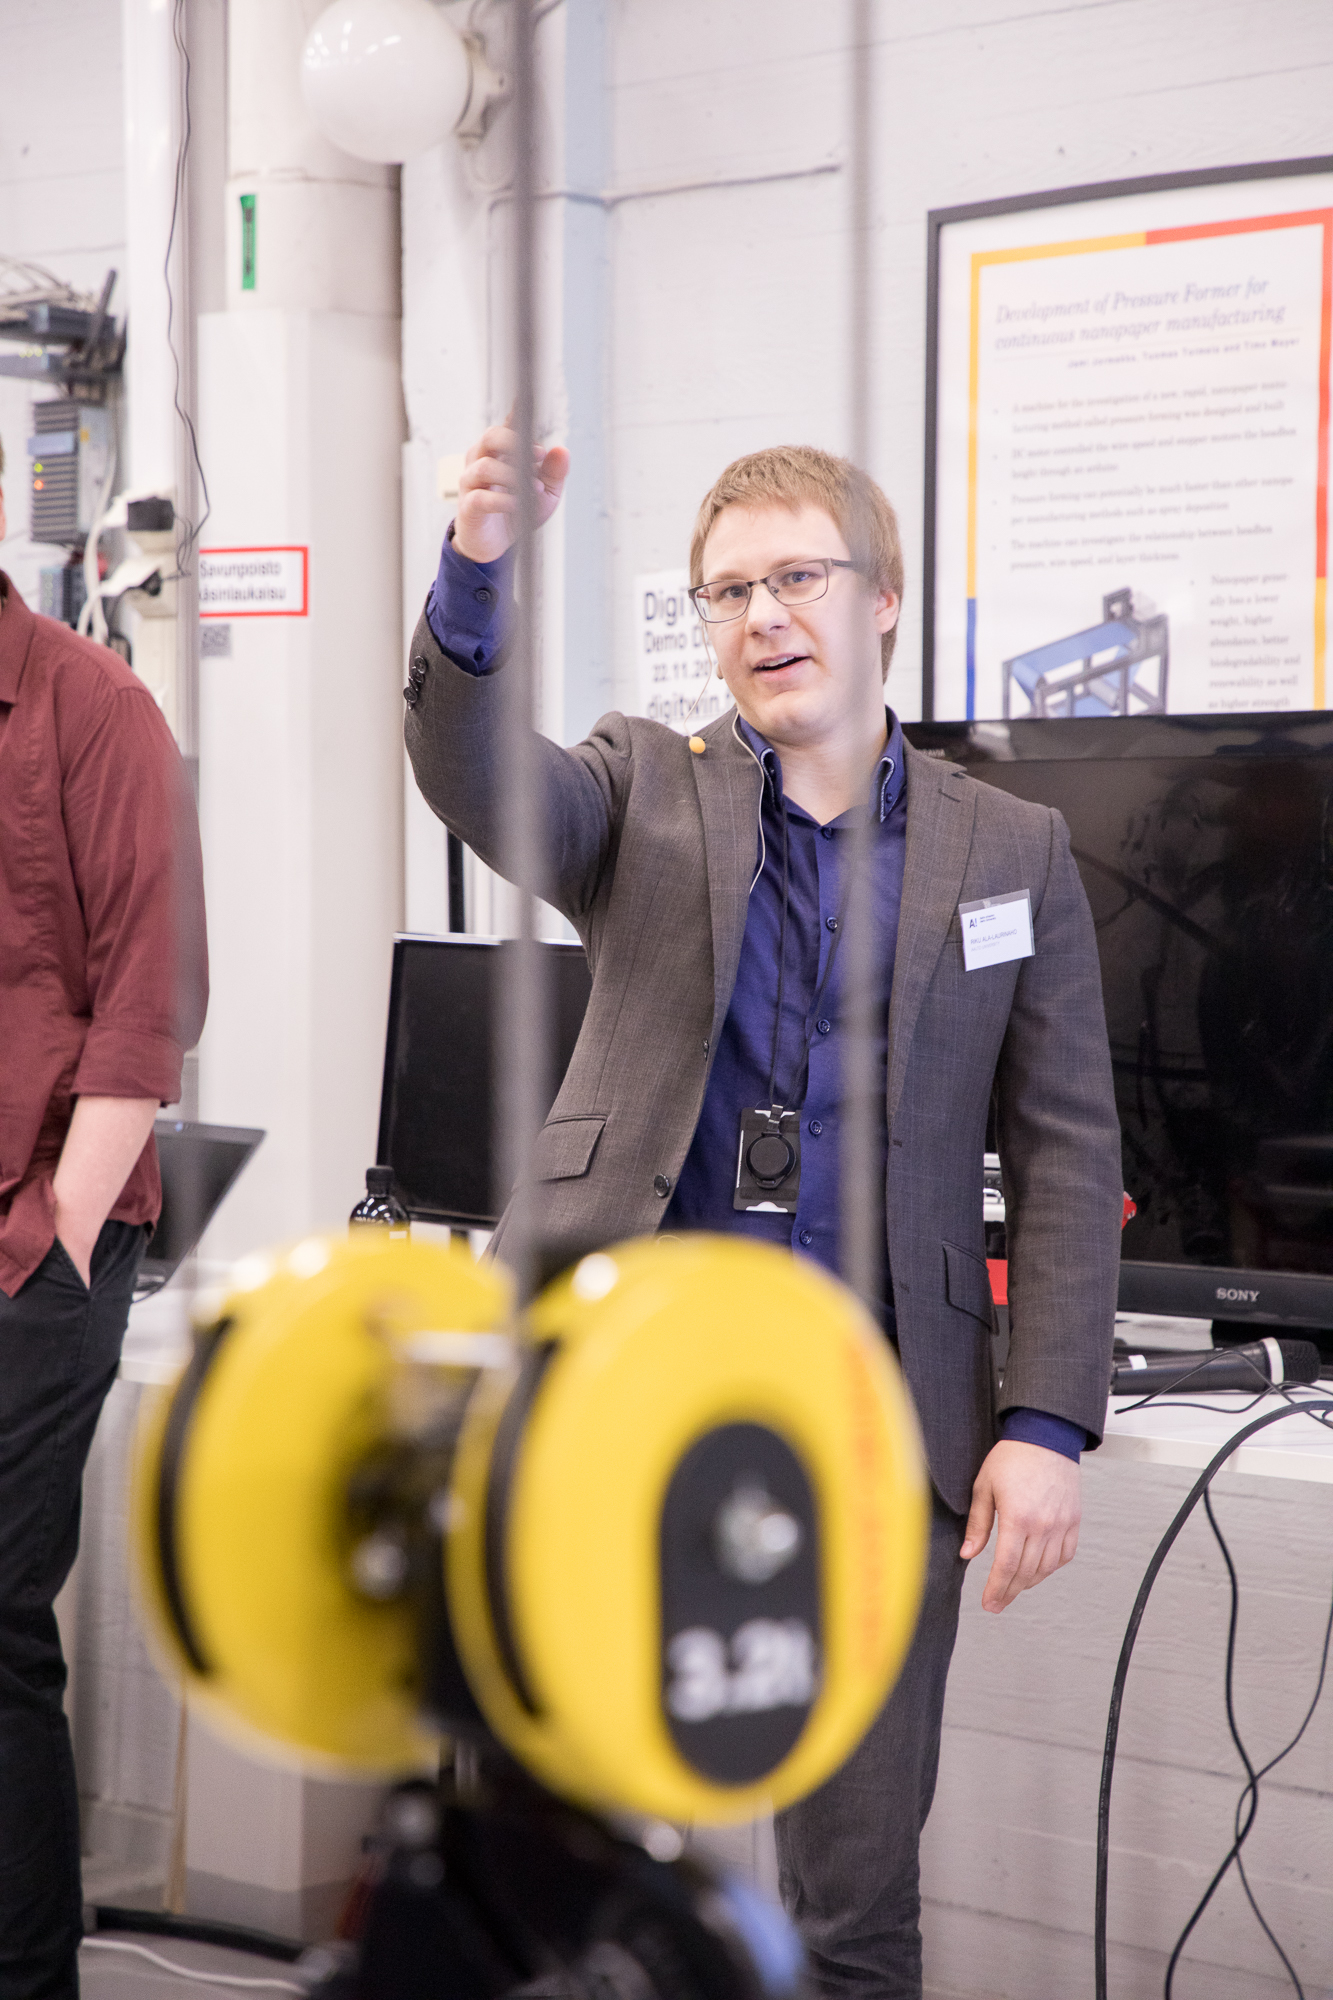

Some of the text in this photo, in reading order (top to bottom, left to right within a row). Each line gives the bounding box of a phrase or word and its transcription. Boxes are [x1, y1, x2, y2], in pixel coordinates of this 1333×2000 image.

[996, 276, 1269, 324] Development of Pressure Former for
[995, 301, 1286, 348] continuous nanopaper manufacturing
[644, 630, 687, 654] Demo
[1216, 1287, 1260, 1302] SONY
